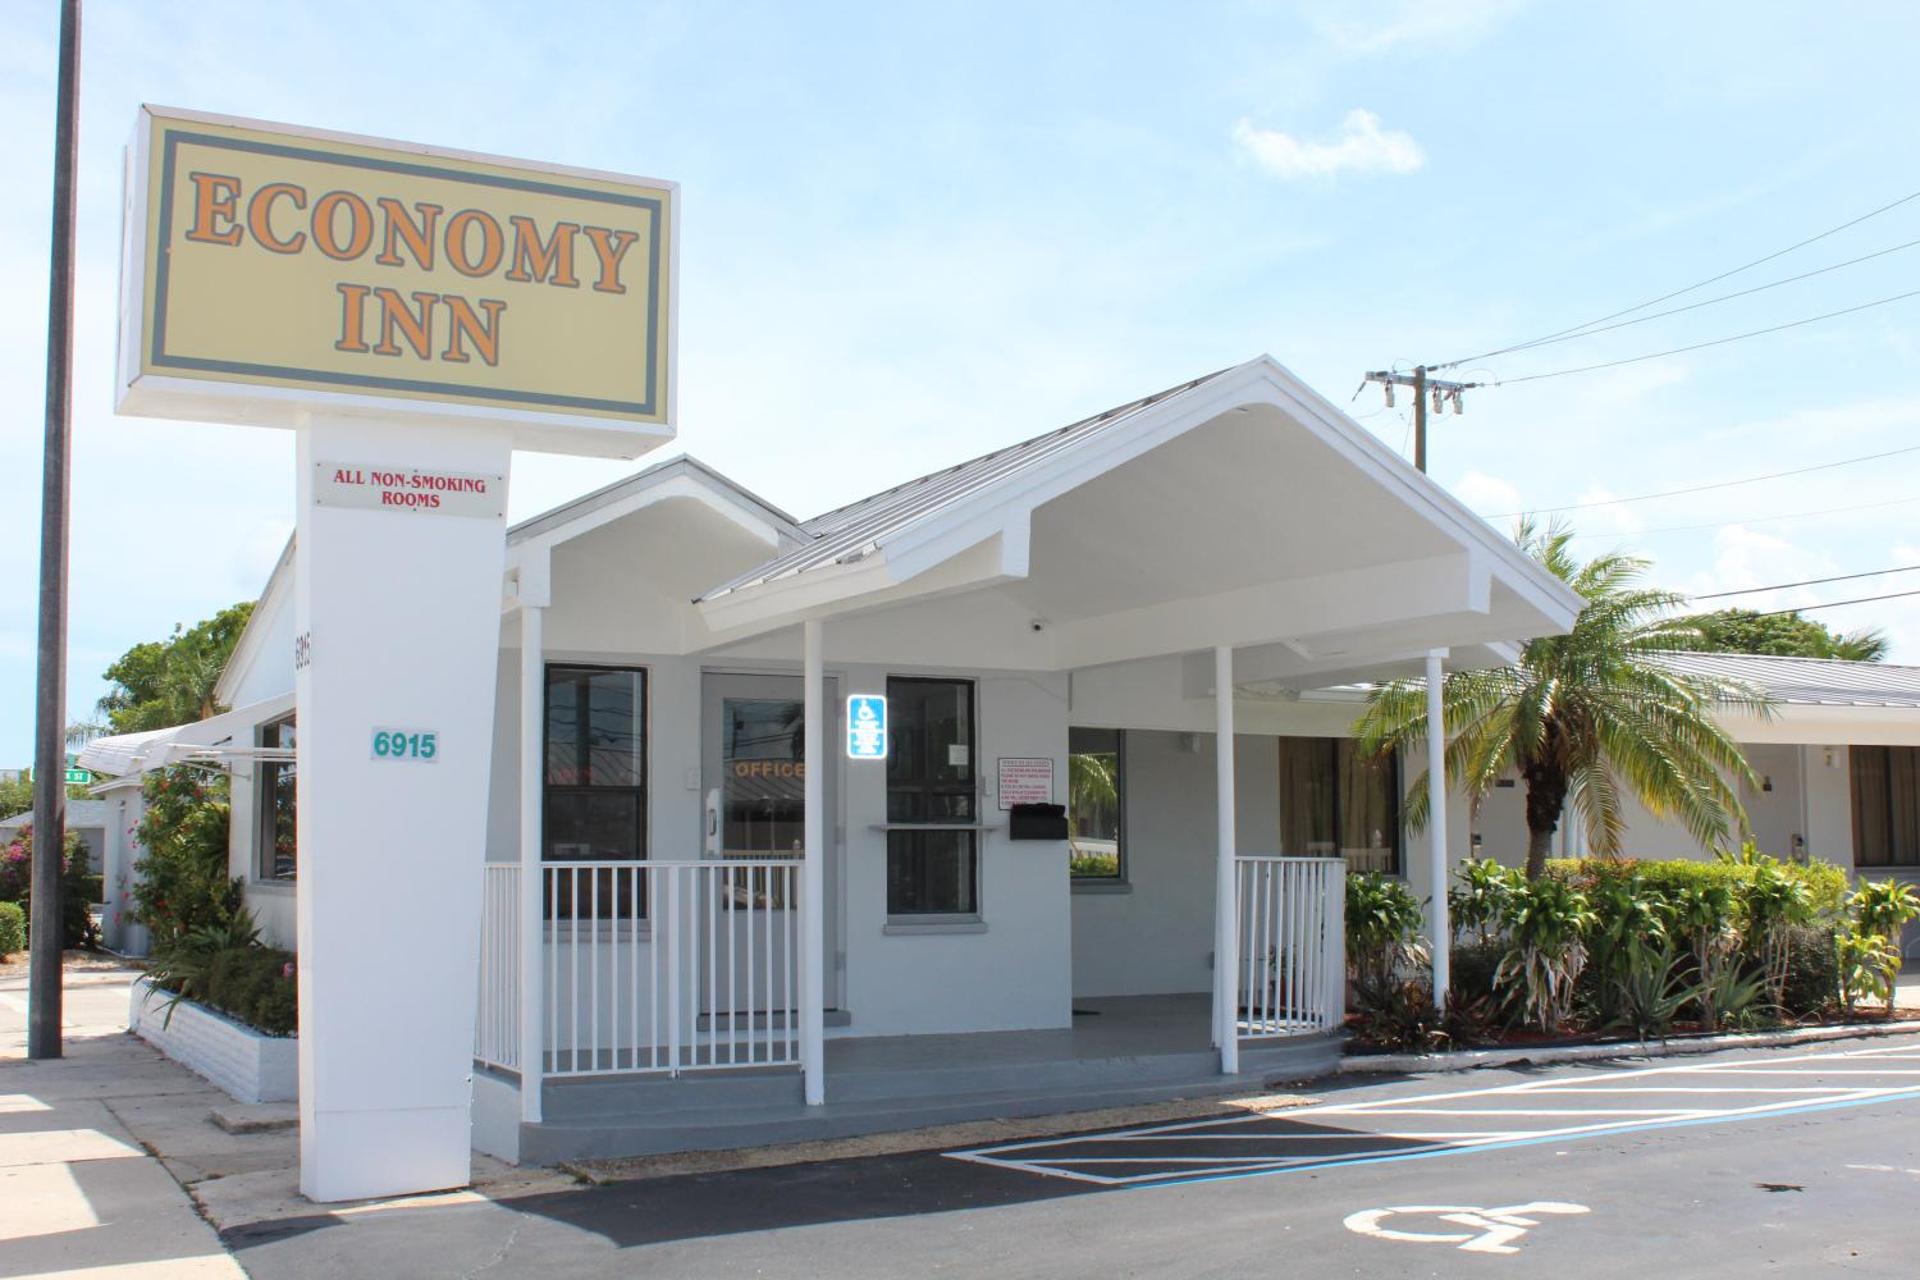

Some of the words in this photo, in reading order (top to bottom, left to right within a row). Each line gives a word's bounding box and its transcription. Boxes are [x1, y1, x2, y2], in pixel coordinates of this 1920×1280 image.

[186, 171, 638, 294] ECONOMY
[335, 283, 507, 367] INN
[334, 469, 365, 485] ALL
[371, 472, 486, 493] NON-SMOKING
[382, 491, 440, 508] ROOMS
[295, 631, 311, 671] 6915
[374, 731, 436, 759] 6915
[735, 762, 805, 778] OFFICE
